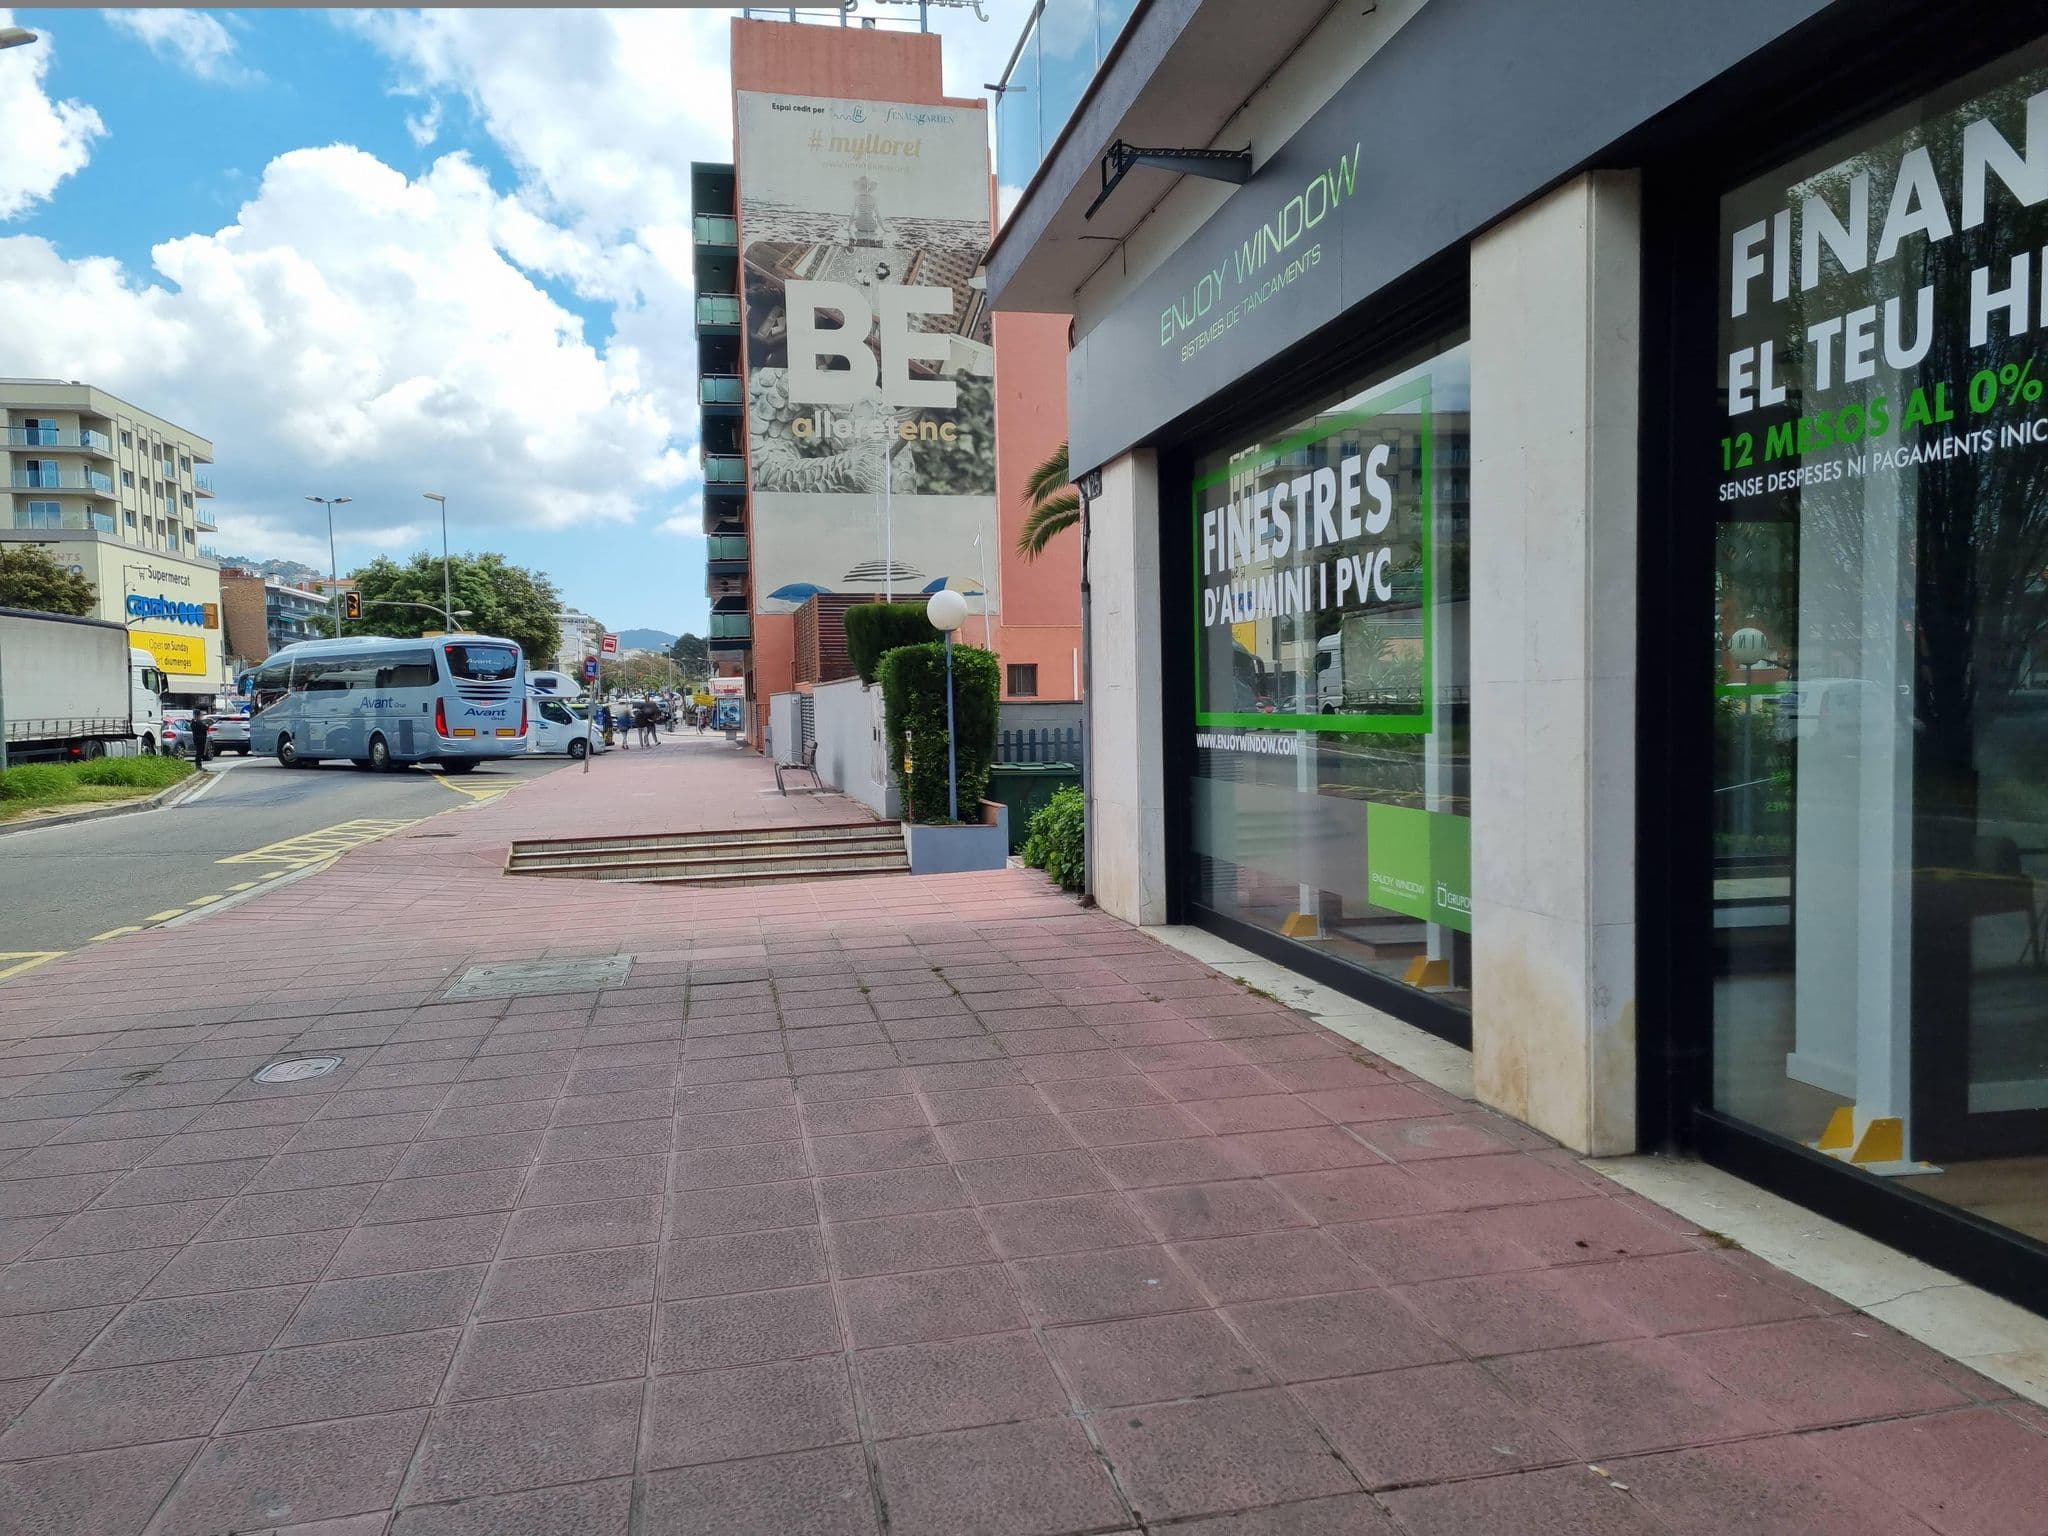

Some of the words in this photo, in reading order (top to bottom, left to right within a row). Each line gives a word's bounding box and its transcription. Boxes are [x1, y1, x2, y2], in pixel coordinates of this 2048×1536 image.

[771, 102, 792, 113] Espai
[793, 104, 811, 113] cedit
[812, 107, 825, 115] per
[1161, 259, 1229, 347] ENJOY
[1234, 141, 1360, 285] WINDOW
[1730, 90, 2048, 319] FINAN
[1181, 317, 1225, 363] SISTEMES
[1226, 306, 1240, 329] DE
[1241, 243, 1321, 316] TANCAMENTS
[784, 279, 957, 409] BE
[1728, 339, 1786, 417] EL
[1807, 285, 1935, 392] TEU
[1720, 436, 1754, 471] 12
[1764, 397, 1890, 465] MESOS
[1902, 382, 1955, 432] AL
[1968, 358, 2043, 414] 0%
[1719, 475, 1763, 502] SENSE
[1767, 459, 1842, 493] DESPESES
[1847, 455, 1867, 475] NI
[1872, 429, 1993, 473] PAGAMENTS
[1203, 444, 1393, 575] FINESTRES
[147, 568, 191, 587] Supermercat
[1204, 565, 1311, 627] D'ALUMINI
[1320, 562, 1327, 610] I
[1337, 547, 1392, 607] PVC
[171, 640, 189, 654] Sunday
[360, 696, 394, 709] Avant
[464, 708, 507, 717] Avant
[1196, 732, 1298, 756] WWW.ENJOYWINDOW.COM
